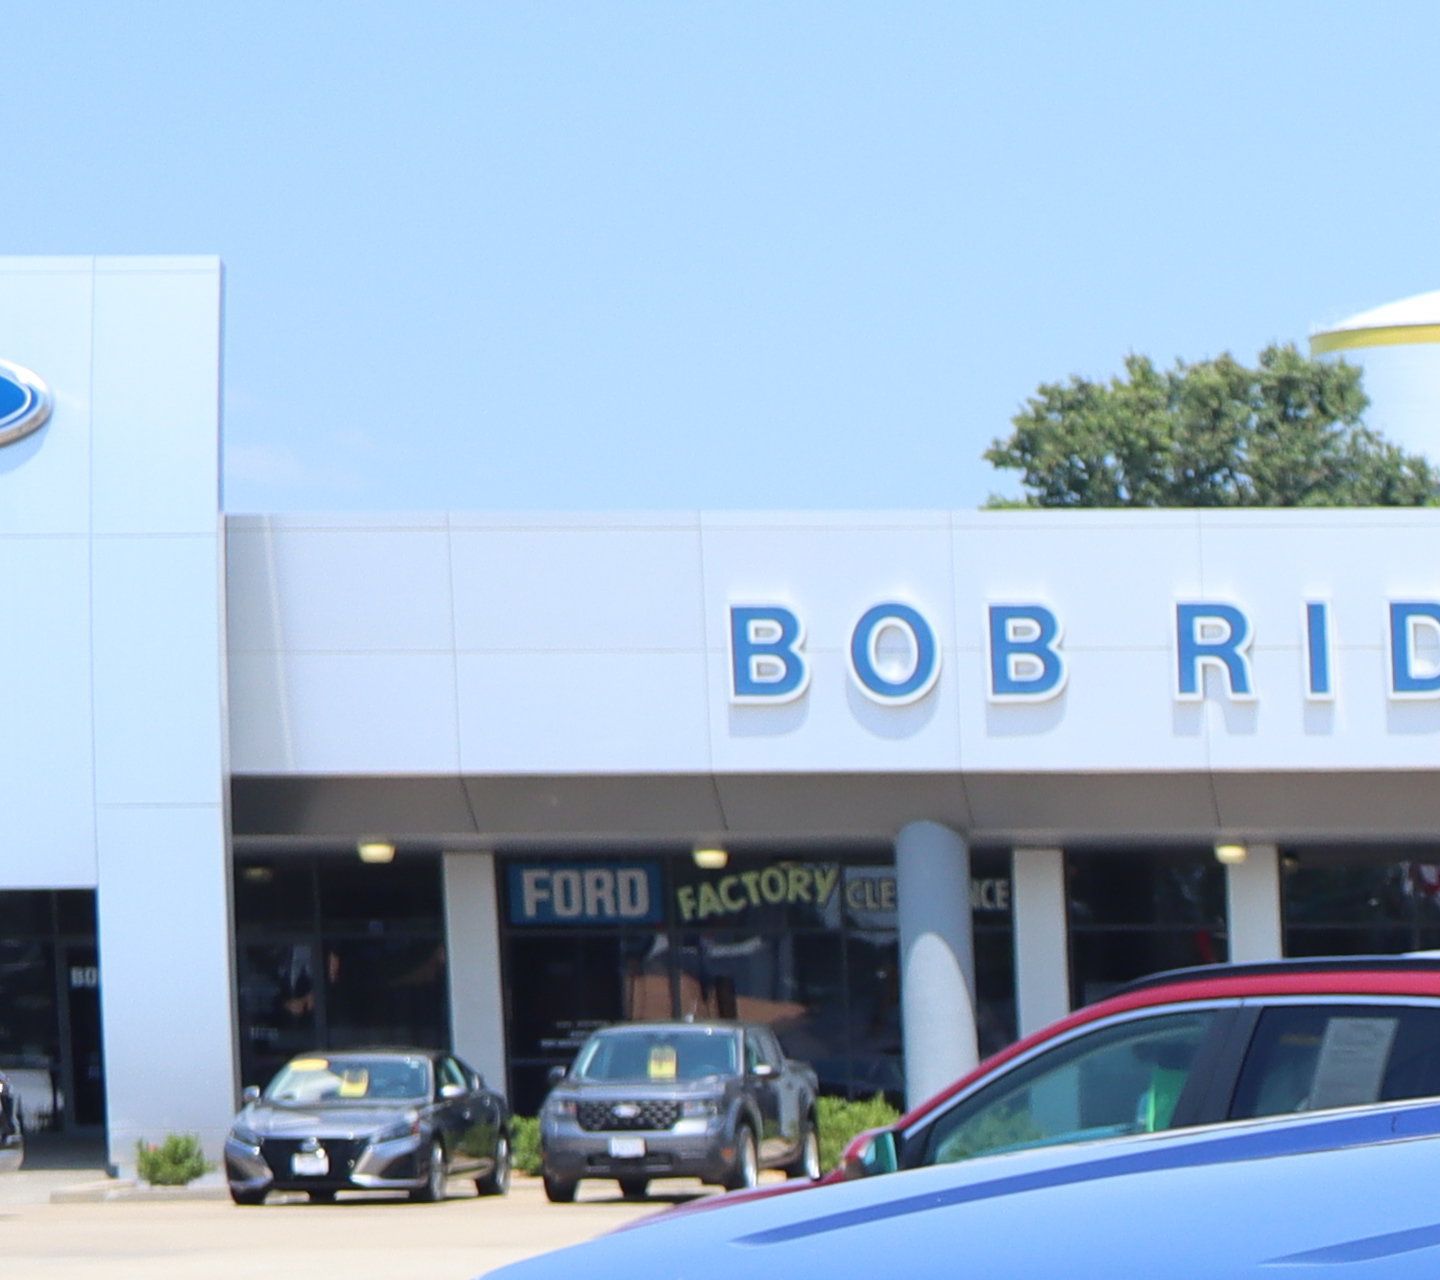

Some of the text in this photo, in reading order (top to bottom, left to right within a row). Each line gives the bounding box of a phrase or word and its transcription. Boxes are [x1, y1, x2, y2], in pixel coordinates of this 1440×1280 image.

[728, 599, 1066, 702] BOB
[523, 868, 649, 917] FORD
[677, 866, 839, 921] FACTORY
